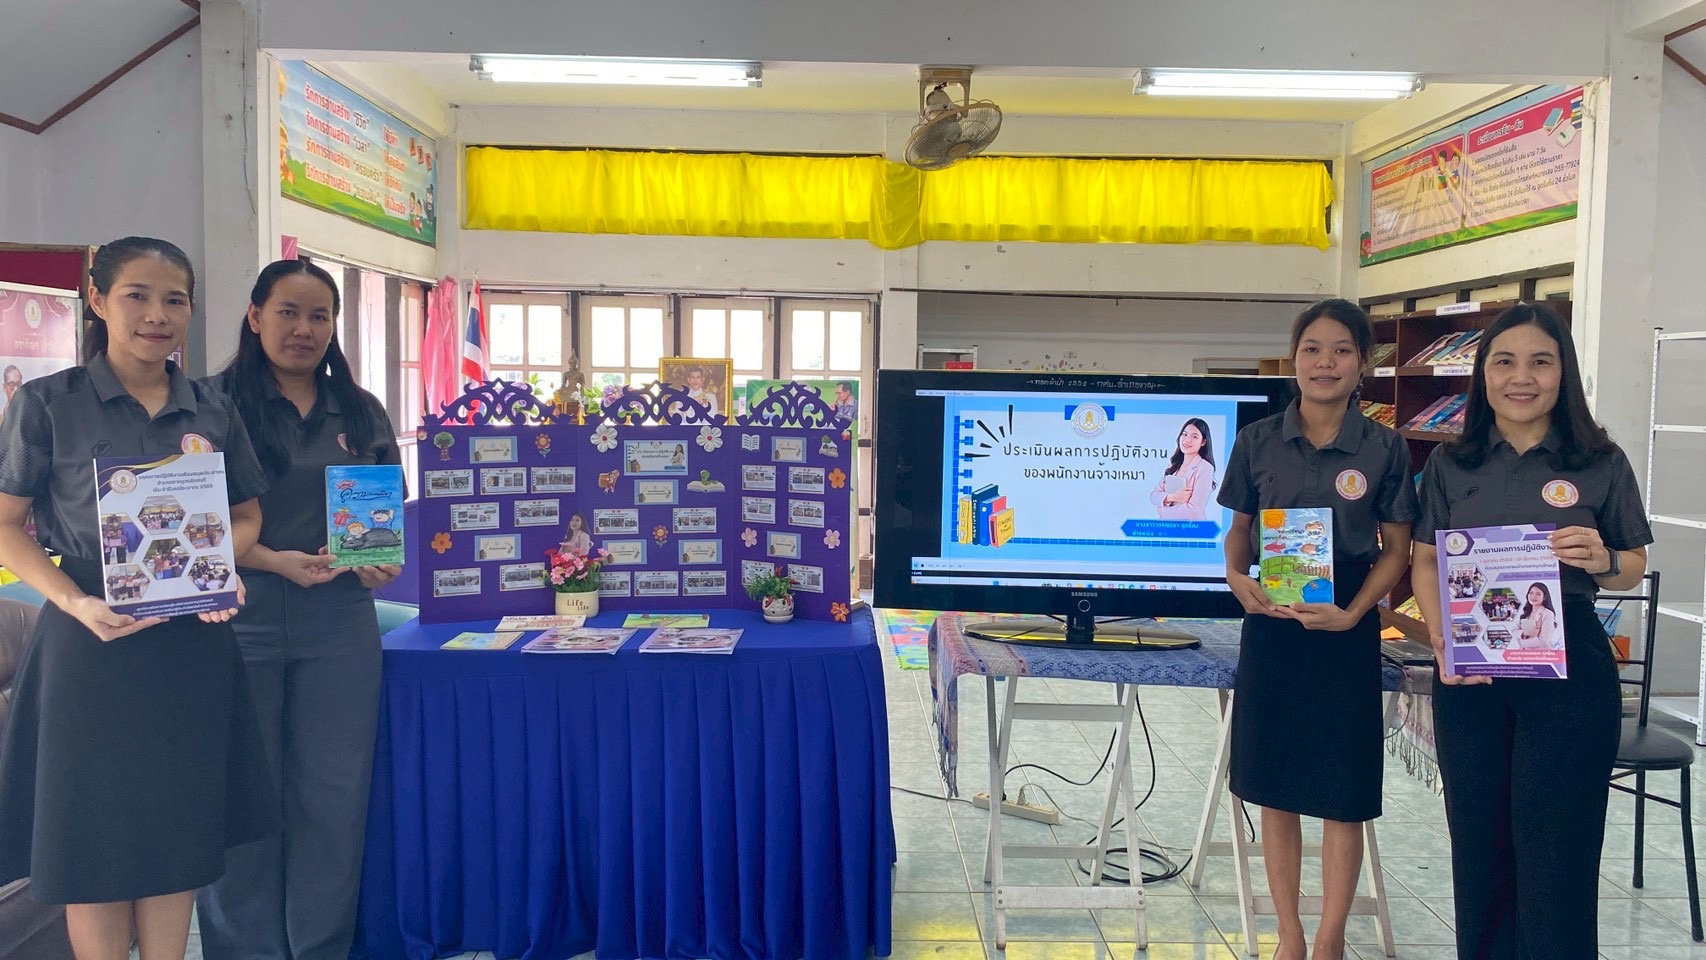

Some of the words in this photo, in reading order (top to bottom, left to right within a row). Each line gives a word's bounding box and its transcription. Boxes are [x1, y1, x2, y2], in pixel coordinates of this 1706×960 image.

[305, 83, 351, 121] รักการอ่านสร้าง
[305, 110, 351, 146] รักการอ่านสร้าง
[305, 138, 351, 170] รักการอ่านสร้าง
[305, 164, 351, 194] รักการอ่านสร้าง
[1003, 441, 1168, 462] ประเมินผลการปฏิบัติงาน
[1024, 462, 1146, 481] ของพนักงานจ้างเหมา
